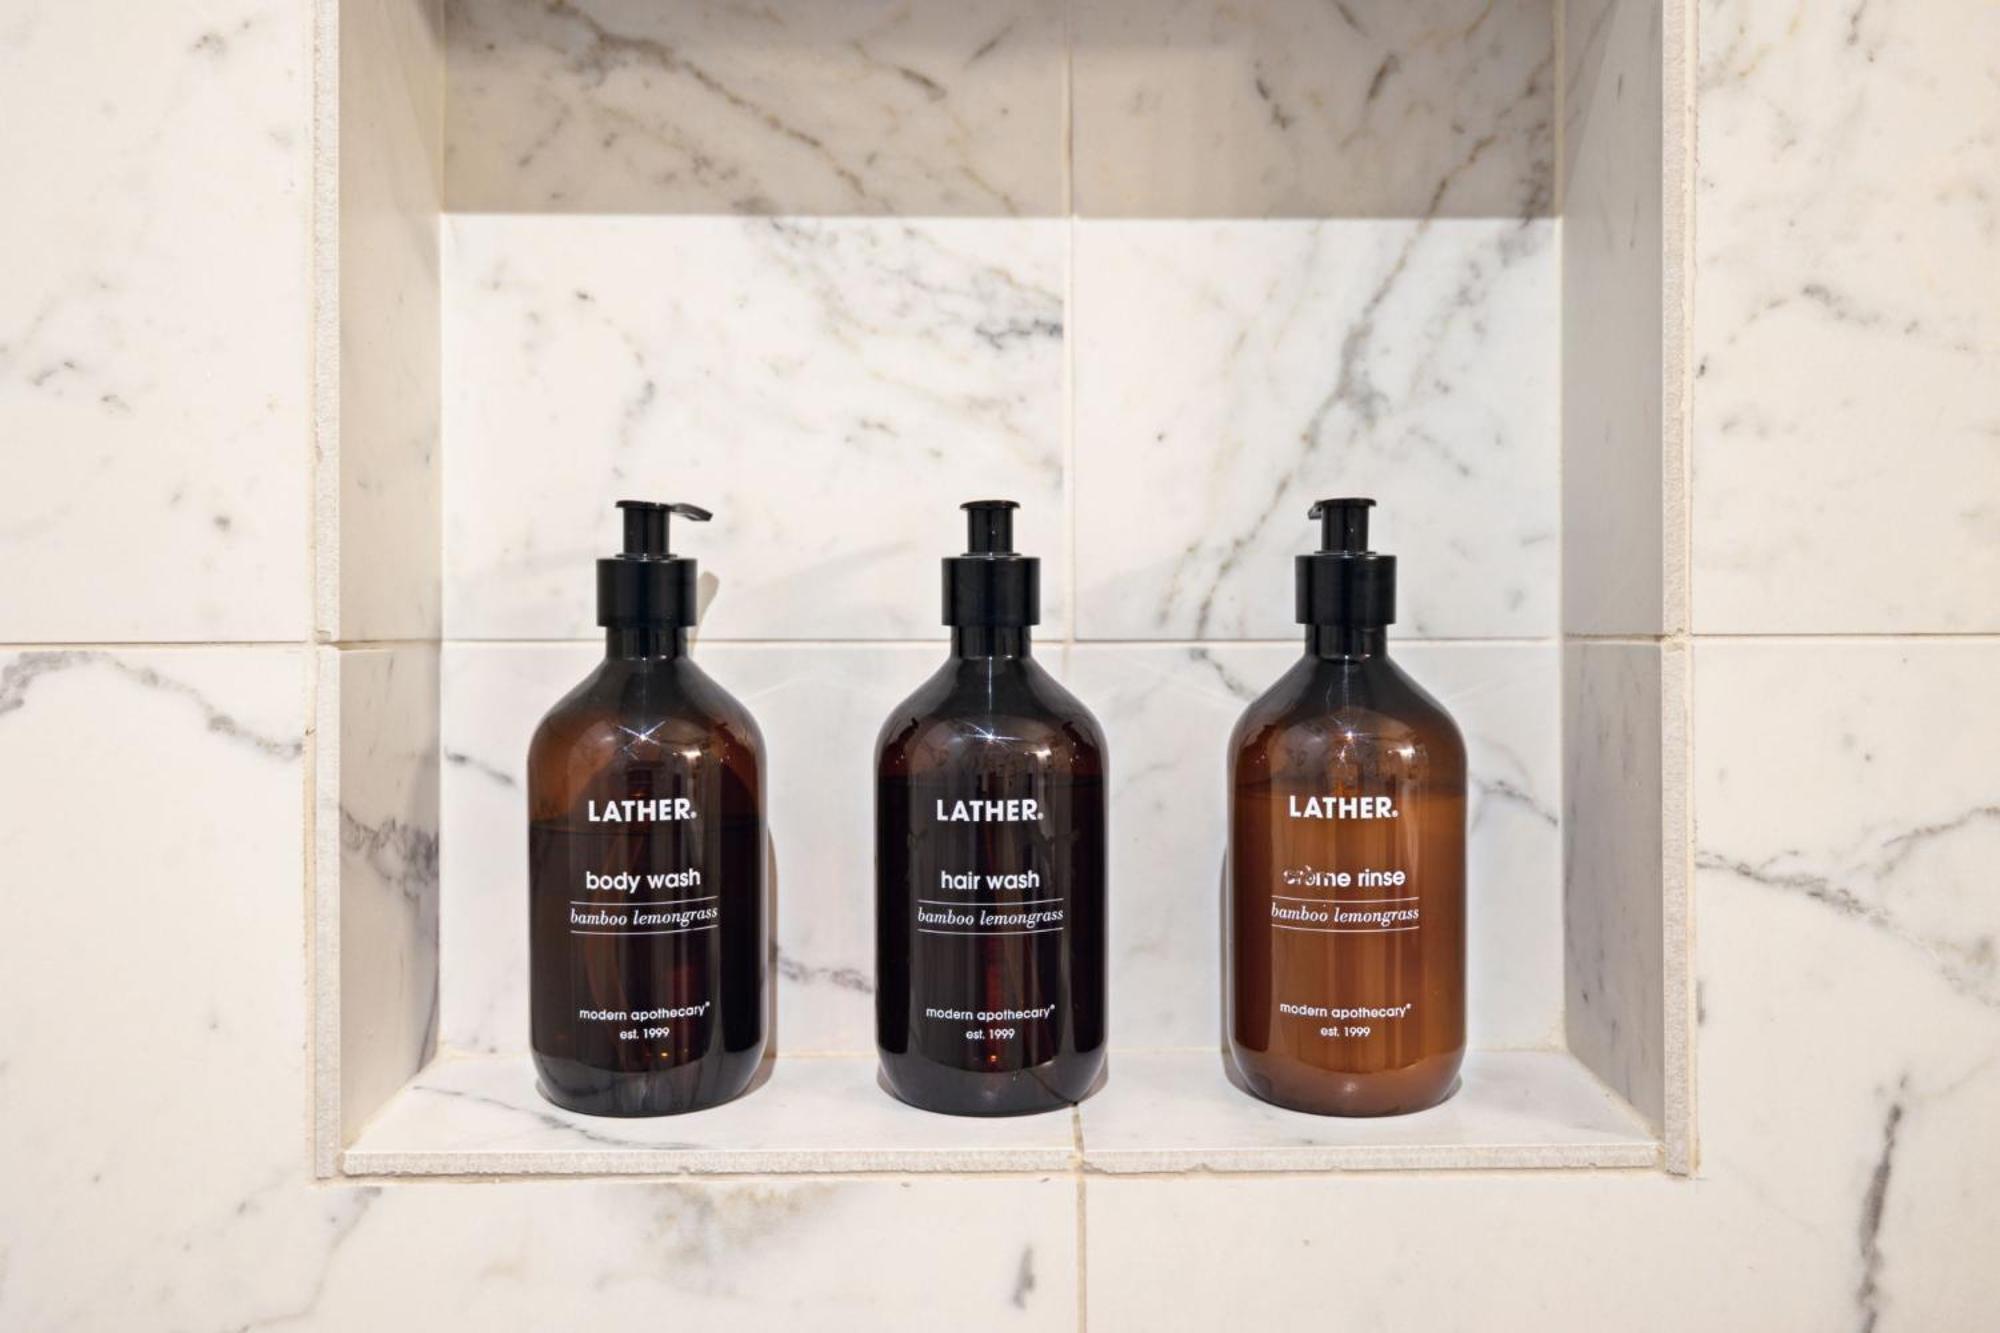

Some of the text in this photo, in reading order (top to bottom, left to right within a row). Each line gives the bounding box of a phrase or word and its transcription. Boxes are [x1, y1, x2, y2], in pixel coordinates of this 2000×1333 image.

[589, 798, 696, 821] LATHER.
[937, 799, 1043, 821] LATHER.
[1290, 796, 1398, 818] LATHER.
[586, 868, 700, 893] body wash
[942, 870, 1039, 889] hair wash
[1359, 869, 1405, 886] rinse
[571, 908, 718, 927] bamboo lemongrass
[918, 907, 1064, 929] bamboo lemongrass
[1272, 903, 1419, 927] bamboo lemongrass
[579, 1009, 627, 1021] modern
[925, 1008, 974, 1021] modern
[1279, 1003, 1328, 1017] modern
[619, 1026, 670, 1040] est. 1999
[965, 1028, 1016, 1040] est. 1999
[1320, 1026, 1371, 1037] est. 1999
